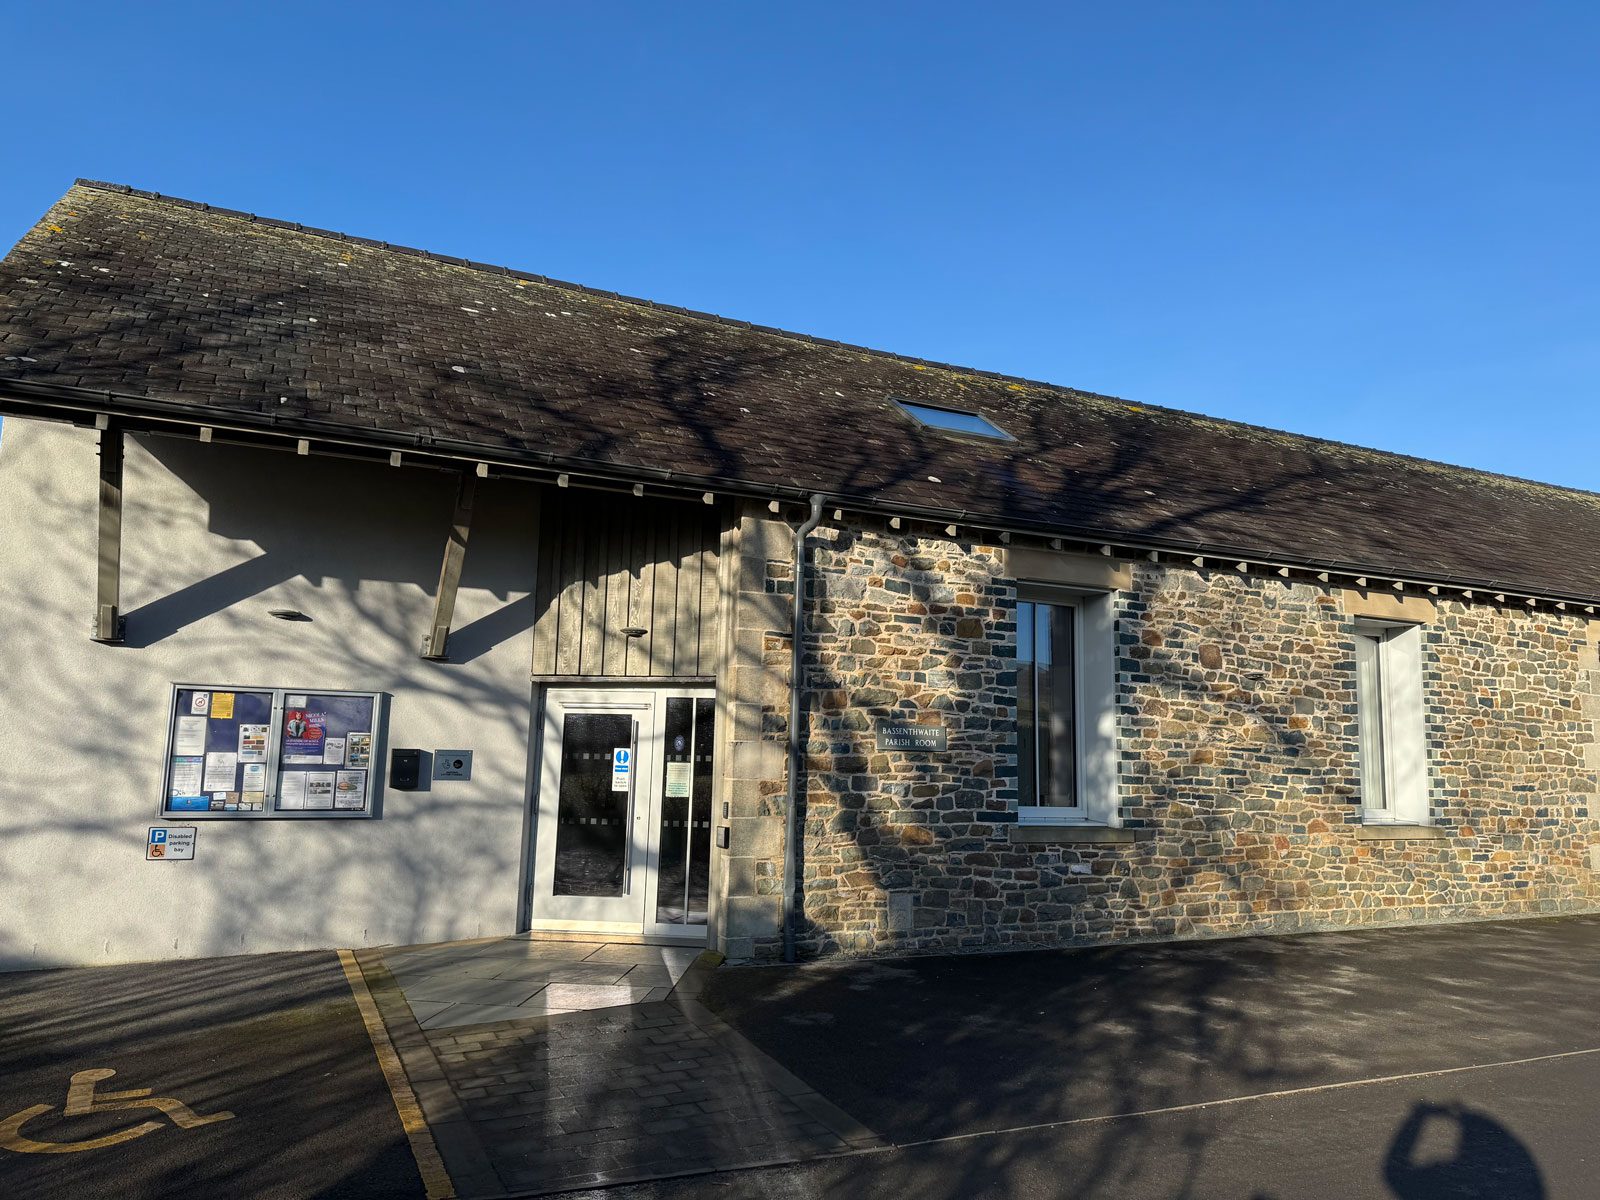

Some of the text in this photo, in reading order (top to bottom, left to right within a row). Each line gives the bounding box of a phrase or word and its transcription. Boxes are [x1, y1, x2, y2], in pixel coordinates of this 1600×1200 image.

[882, 727, 940, 737] BASSENTHWAITE
[885, 738, 910, 746] PARISH
[154, 830, 164, 842] P
